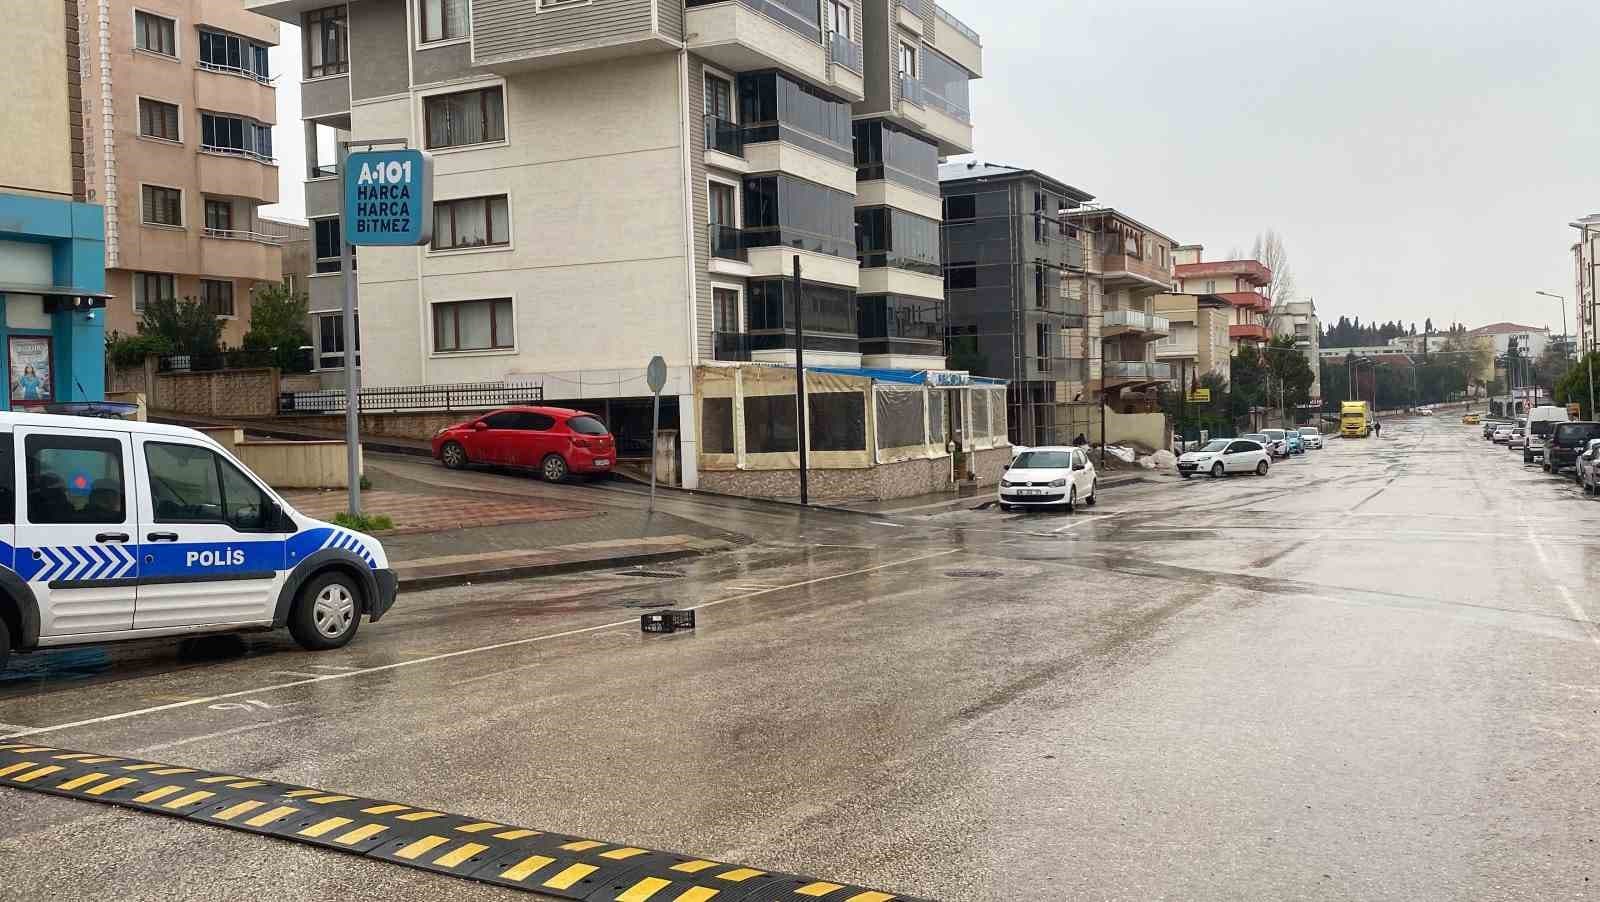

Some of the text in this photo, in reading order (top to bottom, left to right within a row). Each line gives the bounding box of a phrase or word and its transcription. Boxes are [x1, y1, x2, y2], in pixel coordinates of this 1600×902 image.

[357, 185, 410, 200] HARCA
[357, 202, 410, 217] HARCA
[186, 546, 245, 567] POLİS
